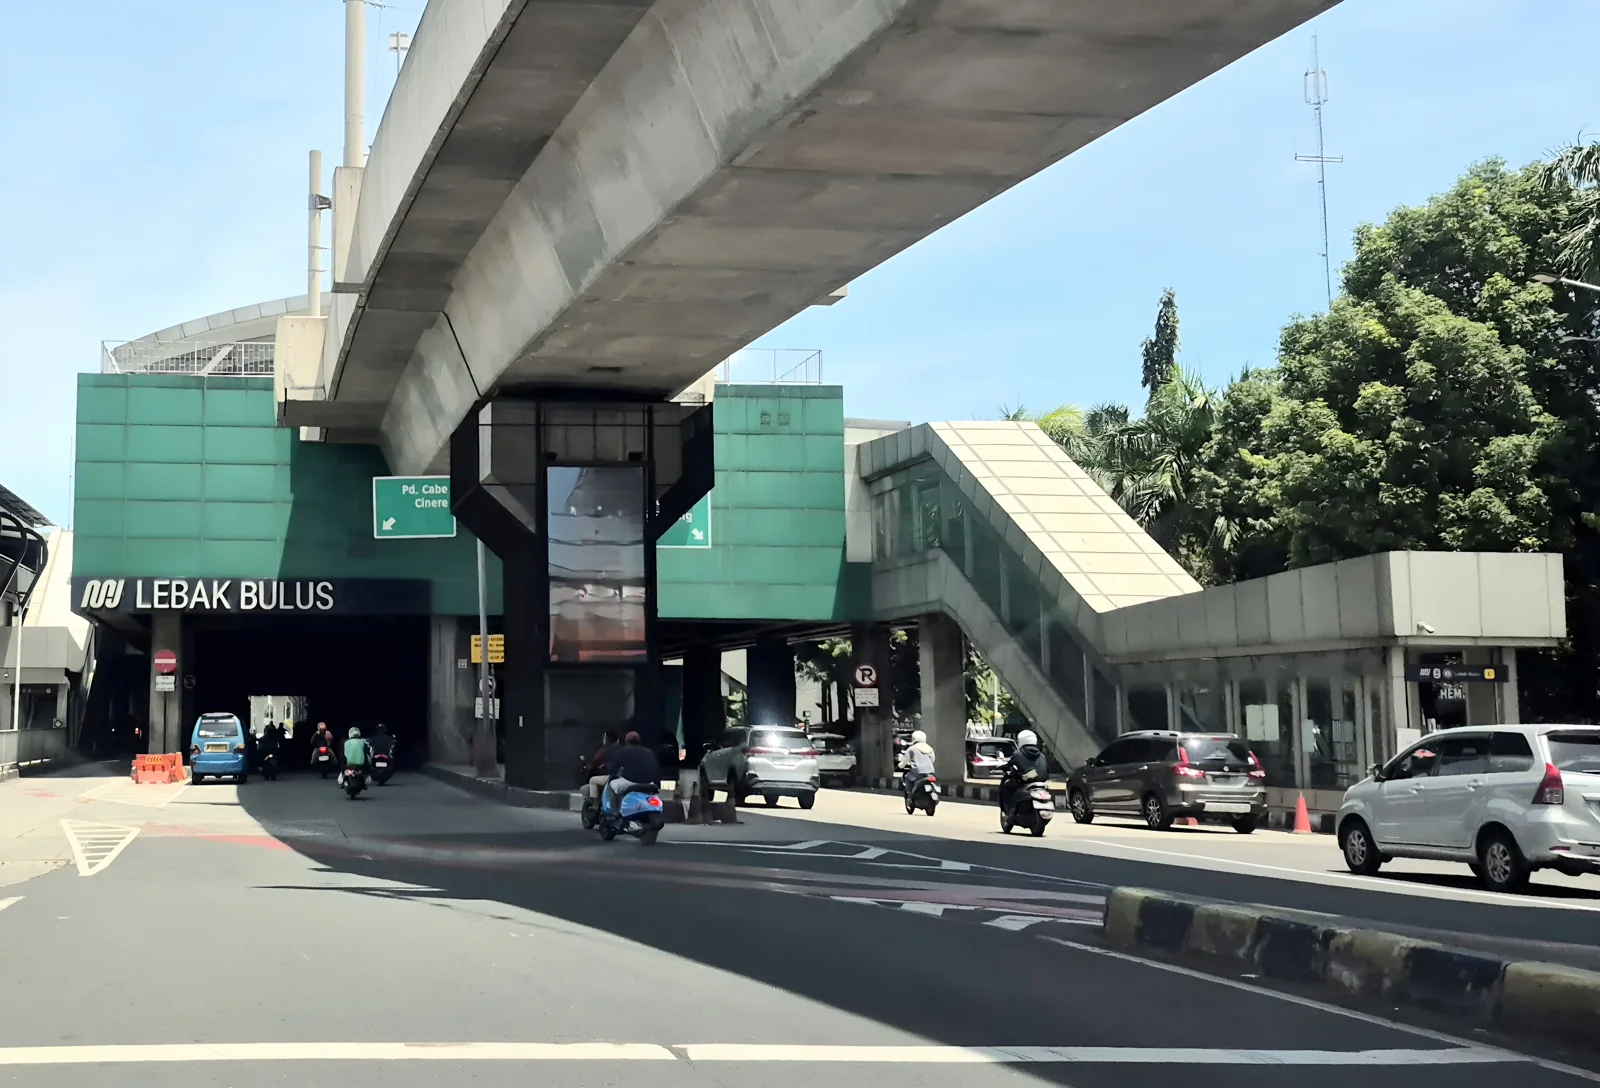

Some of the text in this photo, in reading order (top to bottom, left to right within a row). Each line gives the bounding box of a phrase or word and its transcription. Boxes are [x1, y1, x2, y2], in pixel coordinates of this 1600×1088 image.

[402, 484, 448, 495] Pd. Cabe
[415, 497, 448, 508] Cinere
[136, 579, 334, 610] LEBAK BULUS
